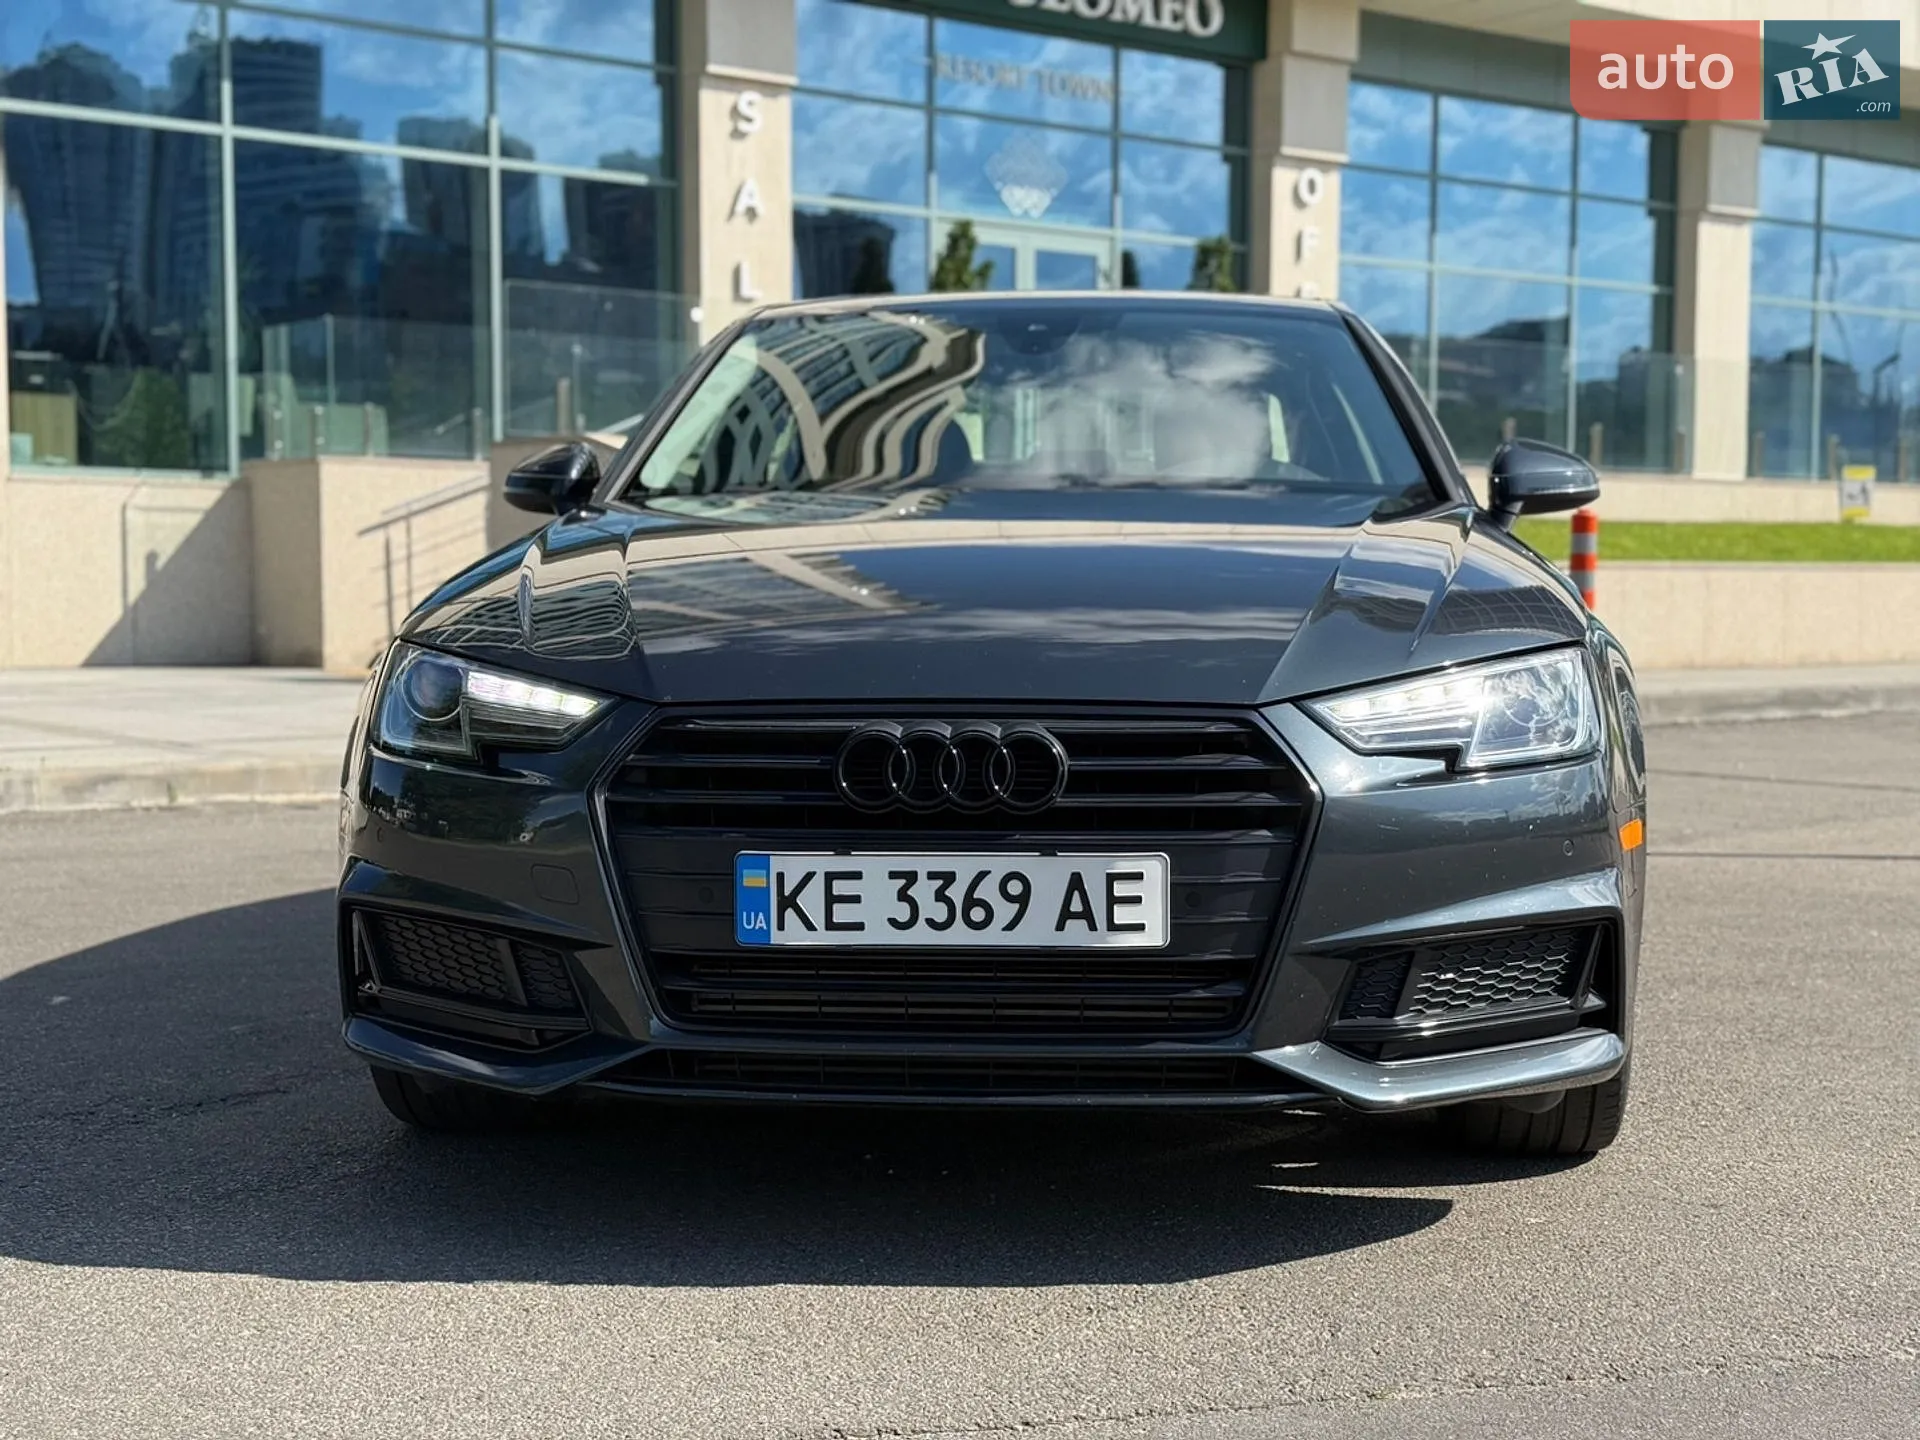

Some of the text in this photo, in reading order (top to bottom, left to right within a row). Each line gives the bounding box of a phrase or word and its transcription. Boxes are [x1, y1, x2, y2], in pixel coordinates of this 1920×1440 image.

[1008, 0, 1225, 38] OMEO
[775, 870, 1146, 932] KE 3369 AE
[743, 911, 768, 930] UA
